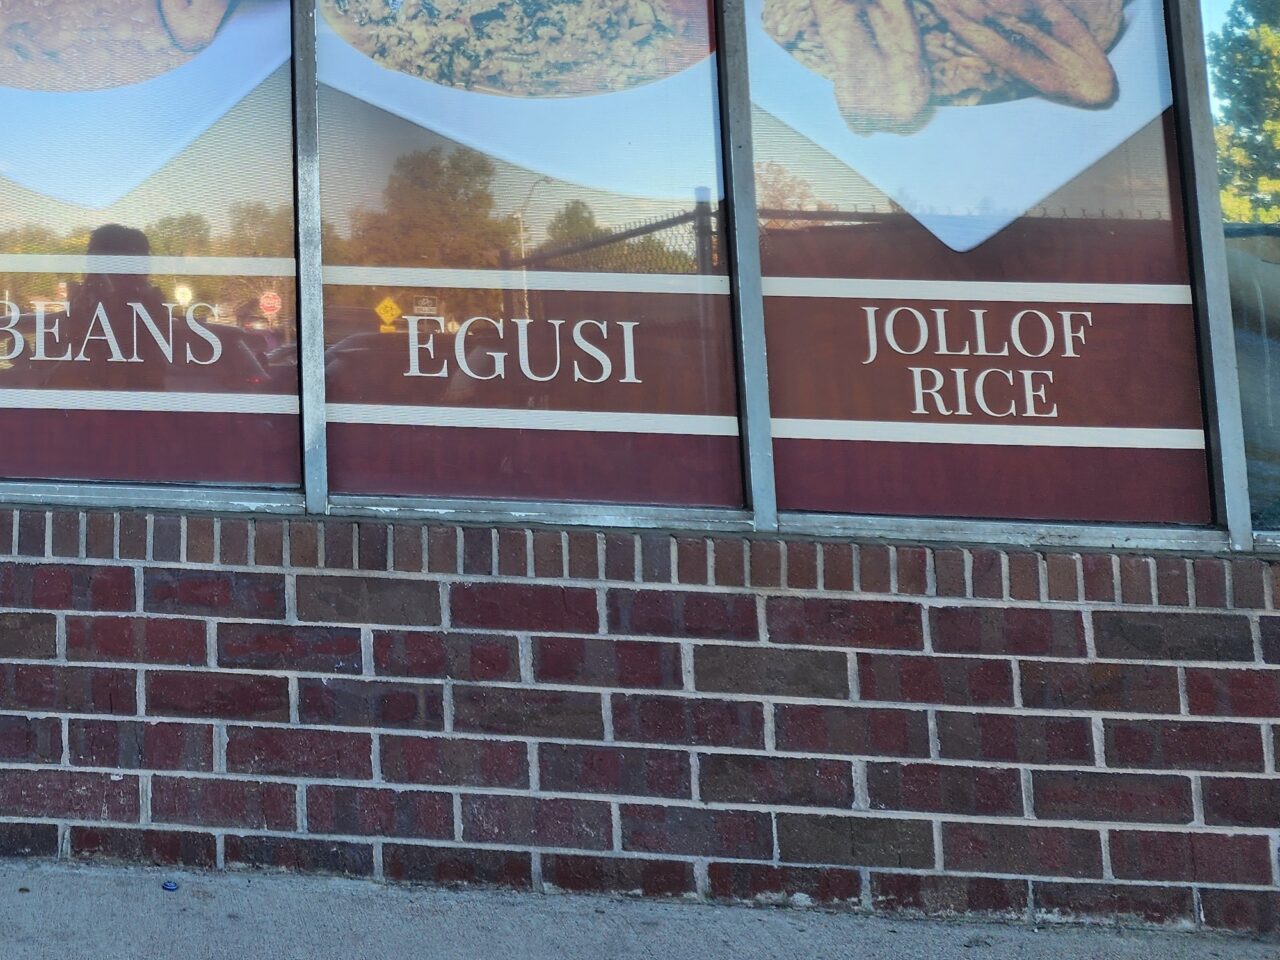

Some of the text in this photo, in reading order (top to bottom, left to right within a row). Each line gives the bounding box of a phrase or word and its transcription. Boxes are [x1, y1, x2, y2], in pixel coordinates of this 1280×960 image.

[402, 315, 643, 384] EGUSI
[860, 306, 1093, 365] JOLLOF
[907, 367, 1059, 418] RICE
